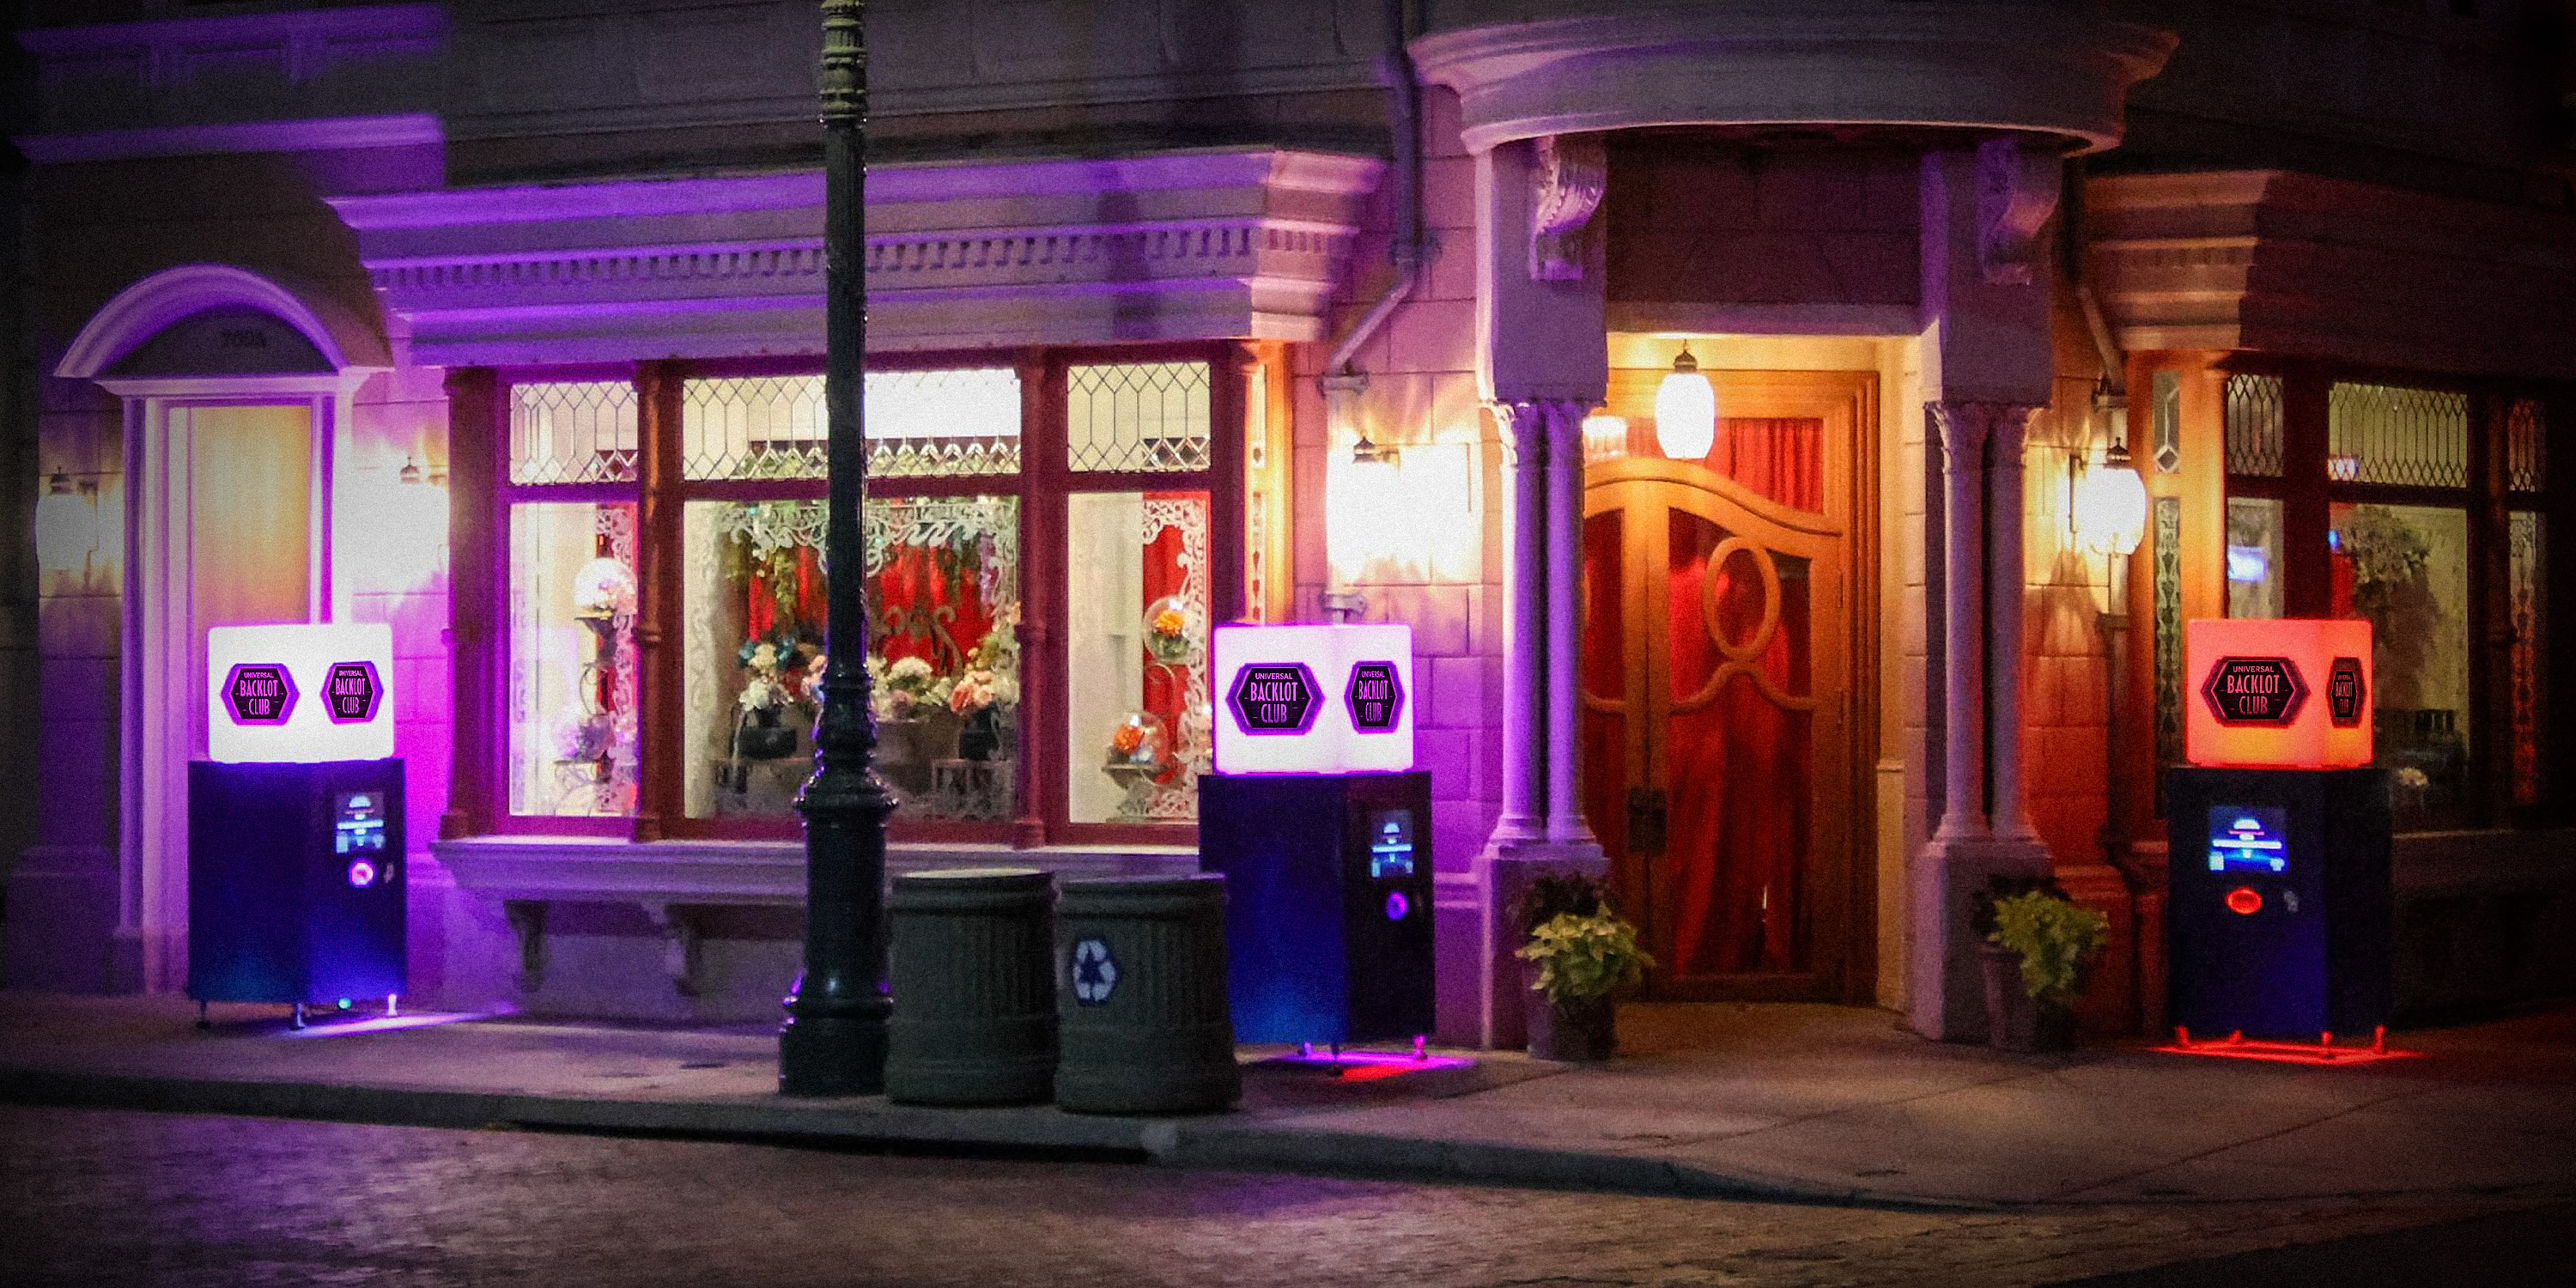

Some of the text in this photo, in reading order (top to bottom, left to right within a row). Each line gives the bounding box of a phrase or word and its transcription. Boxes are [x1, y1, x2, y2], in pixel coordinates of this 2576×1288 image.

[240, 680, 278, 696] BACKLOT
[335, 677, 366, 696] BACKLOT
[1250, 682, 1298, 702] BACKLOT
[1358, 679, 1388, 700] BACKLOT
[2227, 674, 2280, 694] BACKLOT
[2335, 681, 2354, 697] BACKLOT
[248, 698, 270, 714] CLUB
[342, 696, 360, 714] CLUB
[1261, 703, 1287, 723] CLUB
[1365, 702, 1382, 721] CLUB
[2239, 696, 2268, 714] CLUB
